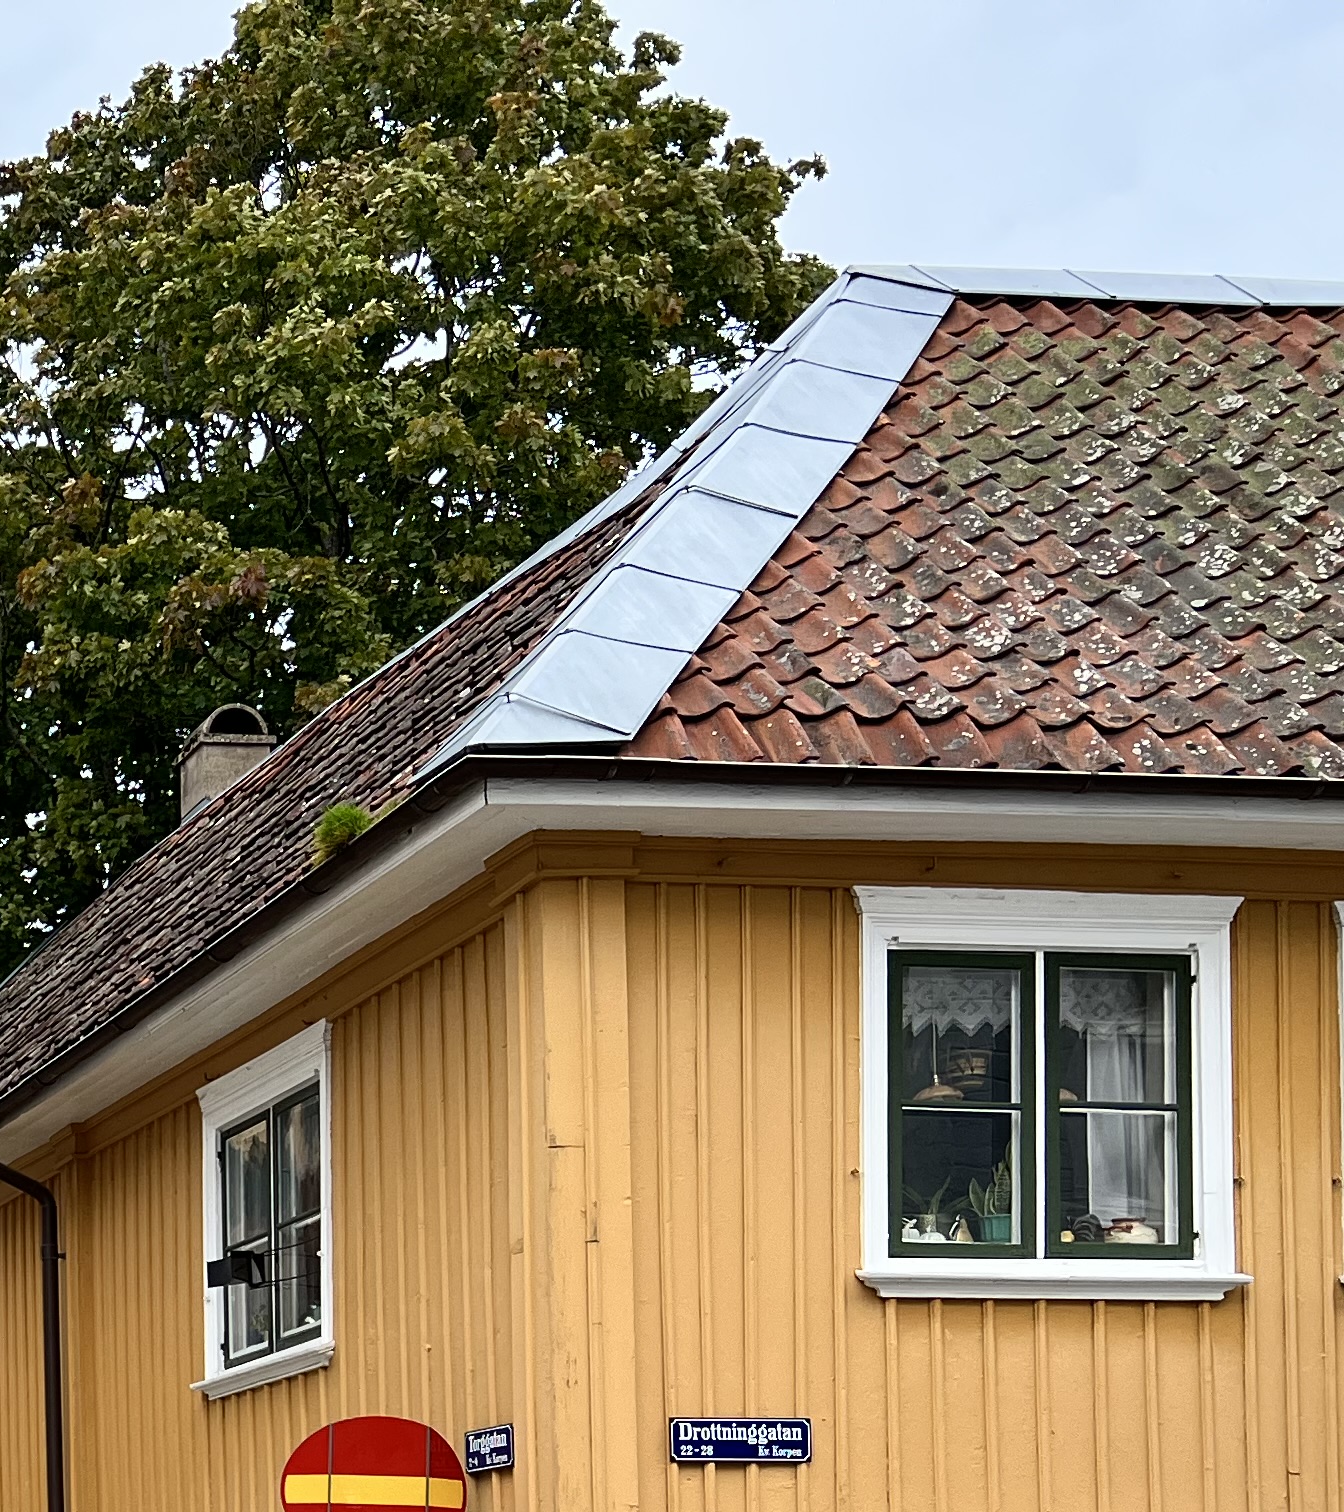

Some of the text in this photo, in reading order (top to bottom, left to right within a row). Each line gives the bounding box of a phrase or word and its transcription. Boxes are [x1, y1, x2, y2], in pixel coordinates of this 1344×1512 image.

[468, 1431, 507, 1454] Torggatan
[678, 1422, 803, 1445] Drottninggatan
[772, 1445, 802, 1458] Korpen
